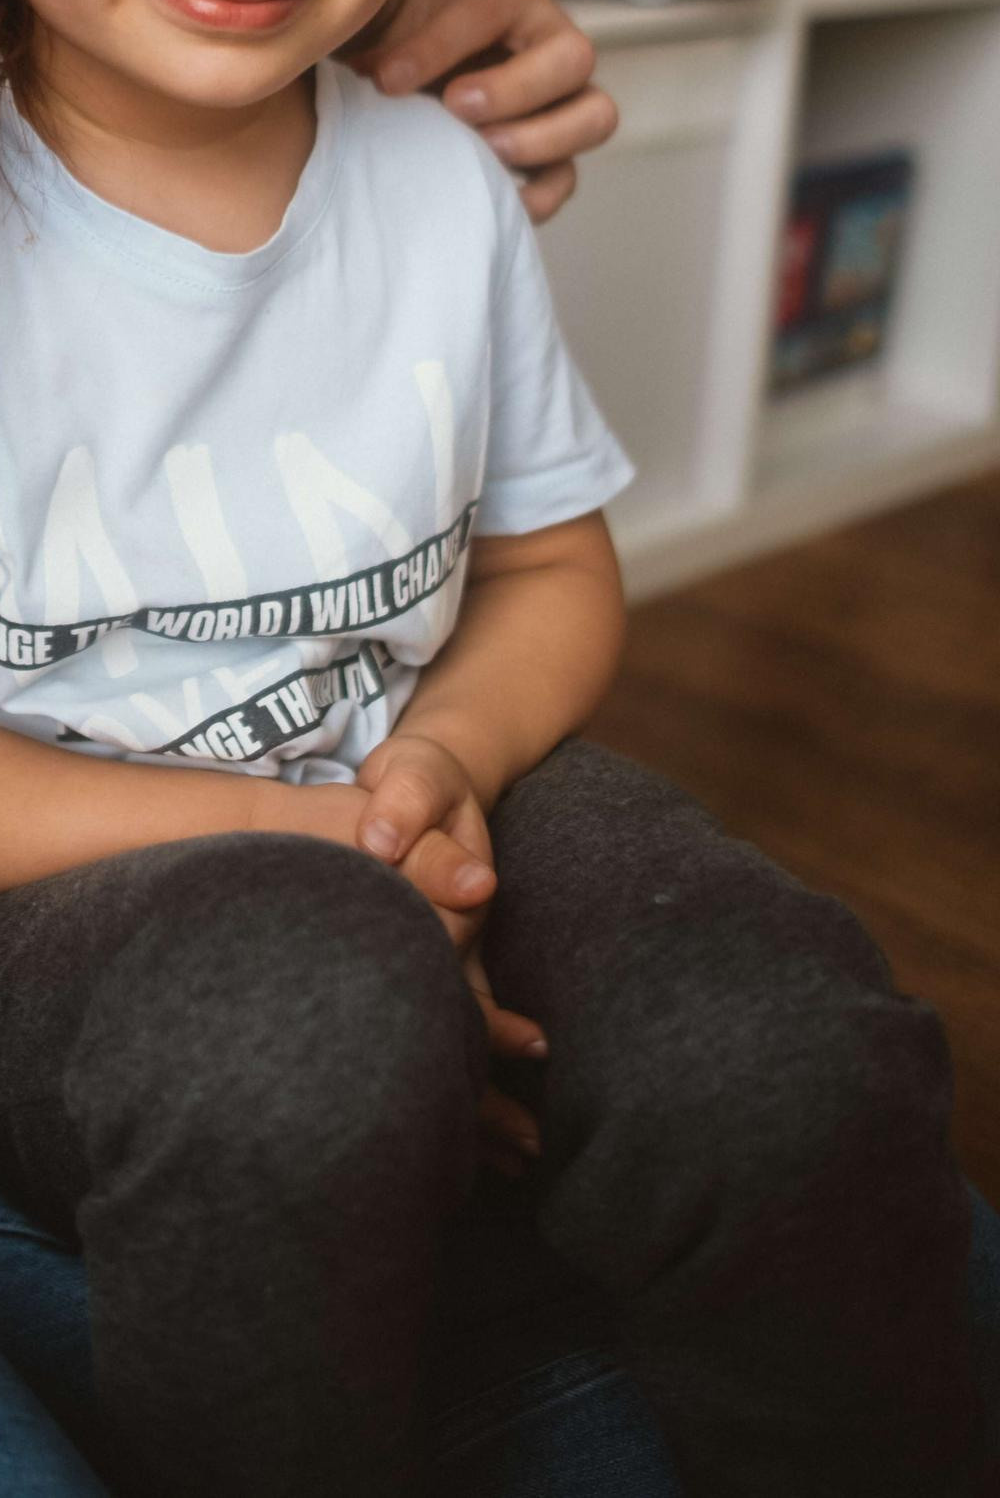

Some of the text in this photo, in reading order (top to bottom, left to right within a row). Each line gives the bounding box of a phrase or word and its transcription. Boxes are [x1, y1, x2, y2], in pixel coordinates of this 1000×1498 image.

[146, 603, 284, 642] WORLD
[287, 595, 301, 635] I
[309, 572, 390, 632] WILL
[392, 524, 460, 609] CHAN
[163, 711, 263, 761] NGE
[255, 677, 320, 734] TH
